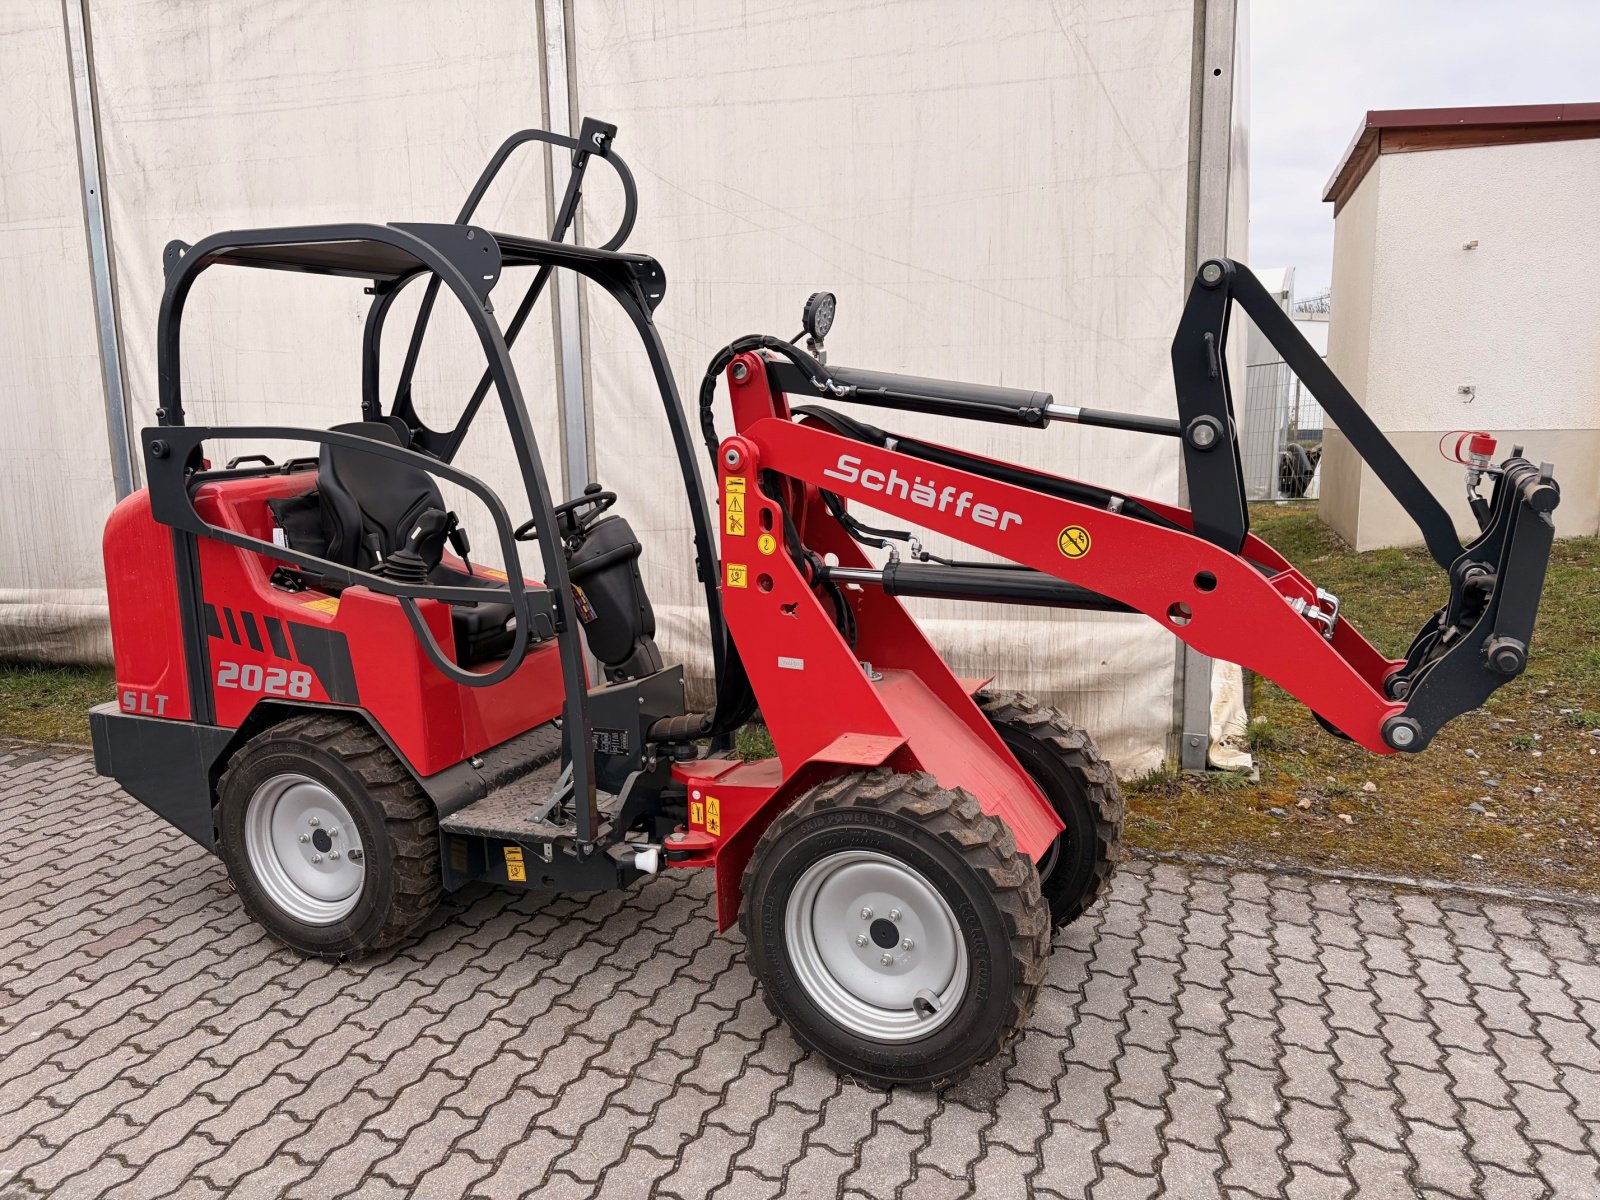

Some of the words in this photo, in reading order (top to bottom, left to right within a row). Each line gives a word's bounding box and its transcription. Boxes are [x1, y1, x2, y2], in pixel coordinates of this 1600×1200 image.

[823, 454, 1023, 531] Schäffer
[217, 661, 312, 698] 2028
[123, 691, 168, 715] SLT
[828, 813, 869, 825] POWER
